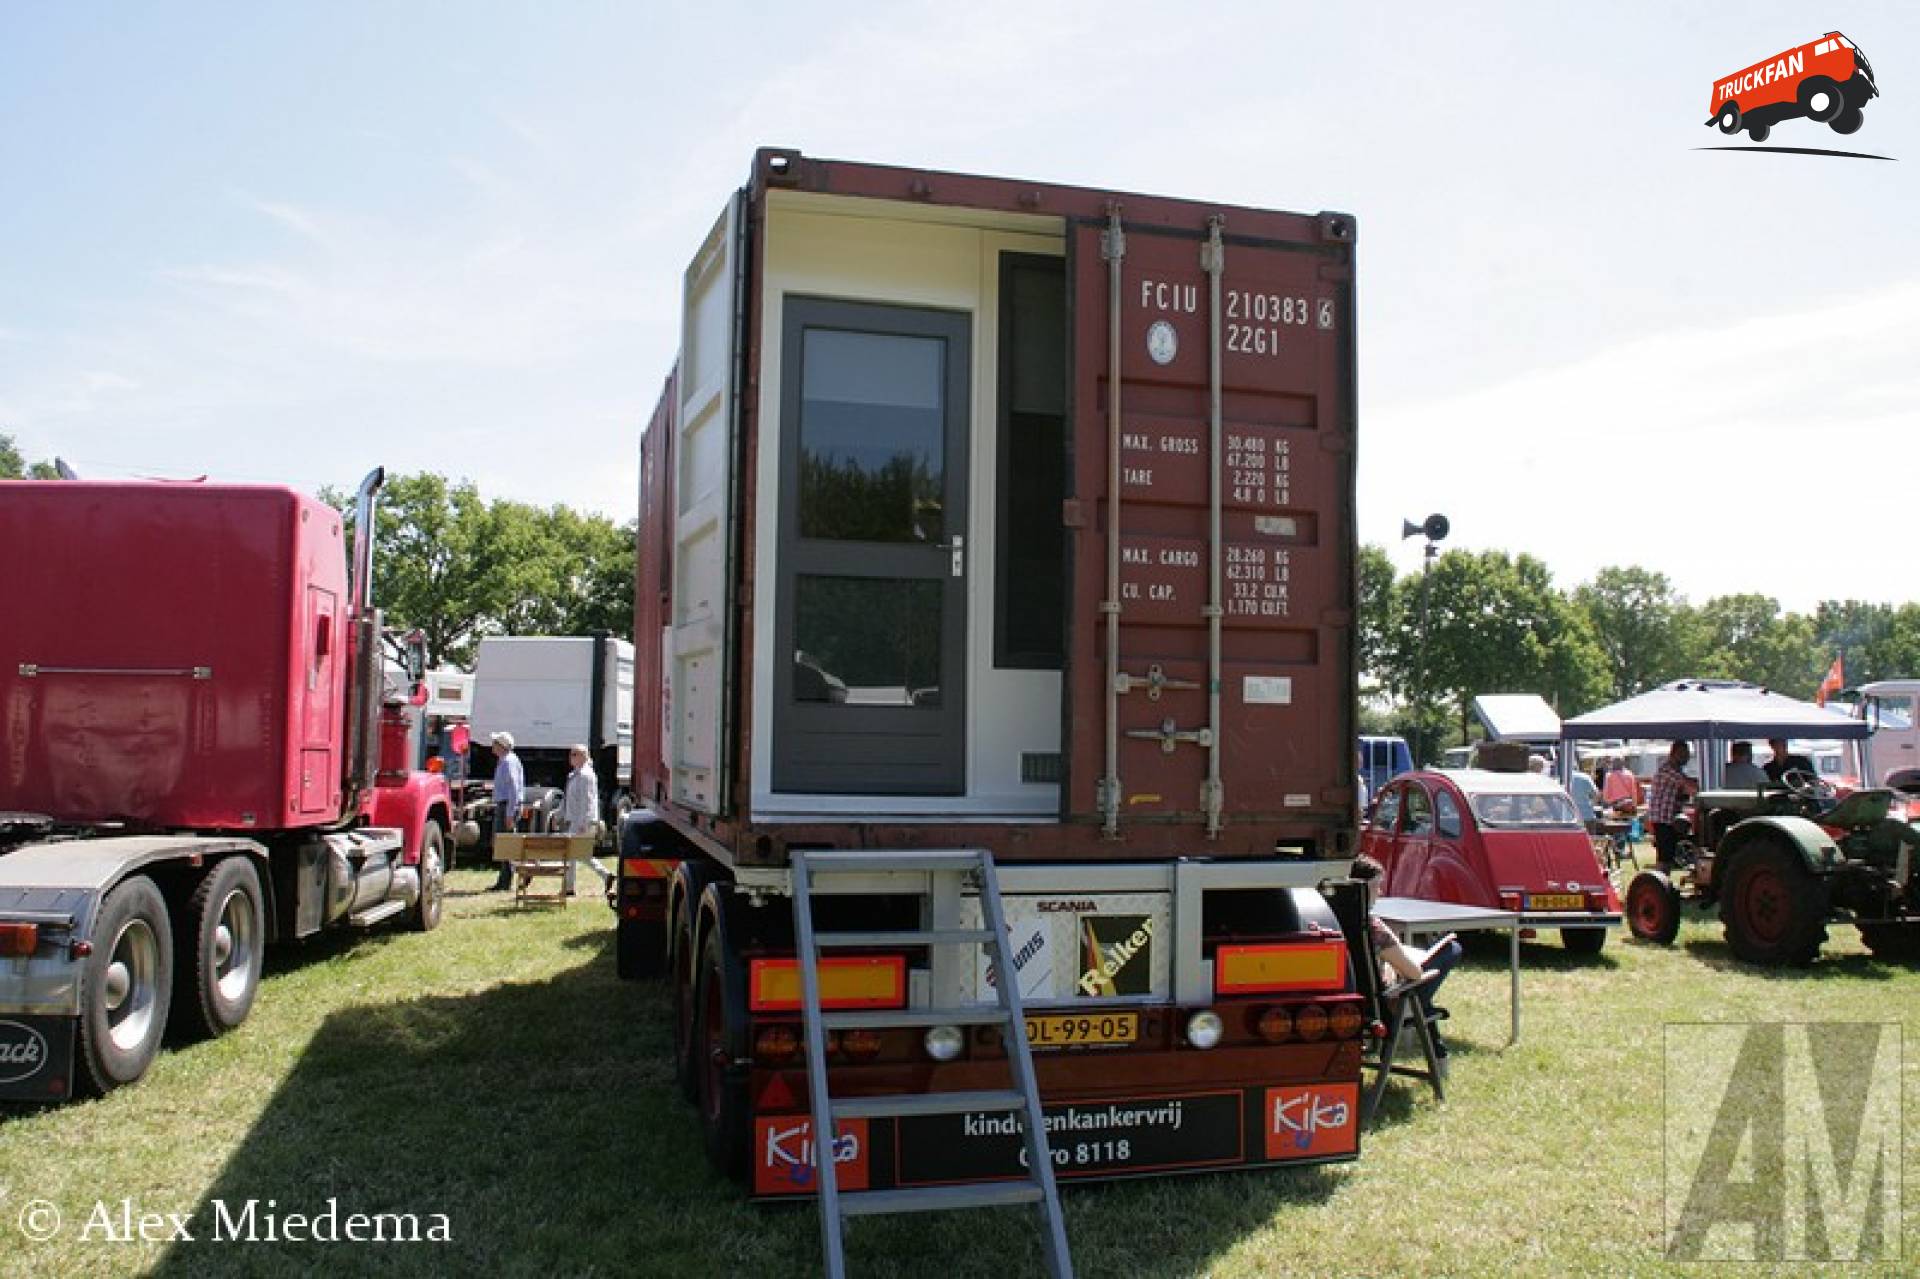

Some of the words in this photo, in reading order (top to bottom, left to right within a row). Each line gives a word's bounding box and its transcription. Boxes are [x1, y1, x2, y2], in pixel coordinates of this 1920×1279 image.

[1141, 280, 1196, 313] FCIU
[1226, 290, 1309, 325] 210383
[1319, 301, 1332, 327] 6
[1226, 324, 1278, 356] 22G1
[1122, 434, 1152, 451] MAX.
[1160, 436, 1199, 454] GROSS
[1275, 438, 1289, 455] KG
[1275, 455, 1289, 471] LB
[1123, 468, 1152, 486] TARE
[1275, 472, 1289, 488] KG
[1275, 488, 1289, 505] LB
[1122, 548, 1152, 565] MAX.
[1160, 549, 1199, 567] CARGO
[1275, 550, 1289, 565] KG
[1275, 565, 1289, 582] LB
[1036, 901, 1097, 912] SCANIA
[964, 1101, 1182, 1136] kindenkankervrij
[1076, 1140, 1131, 1163] 8118
